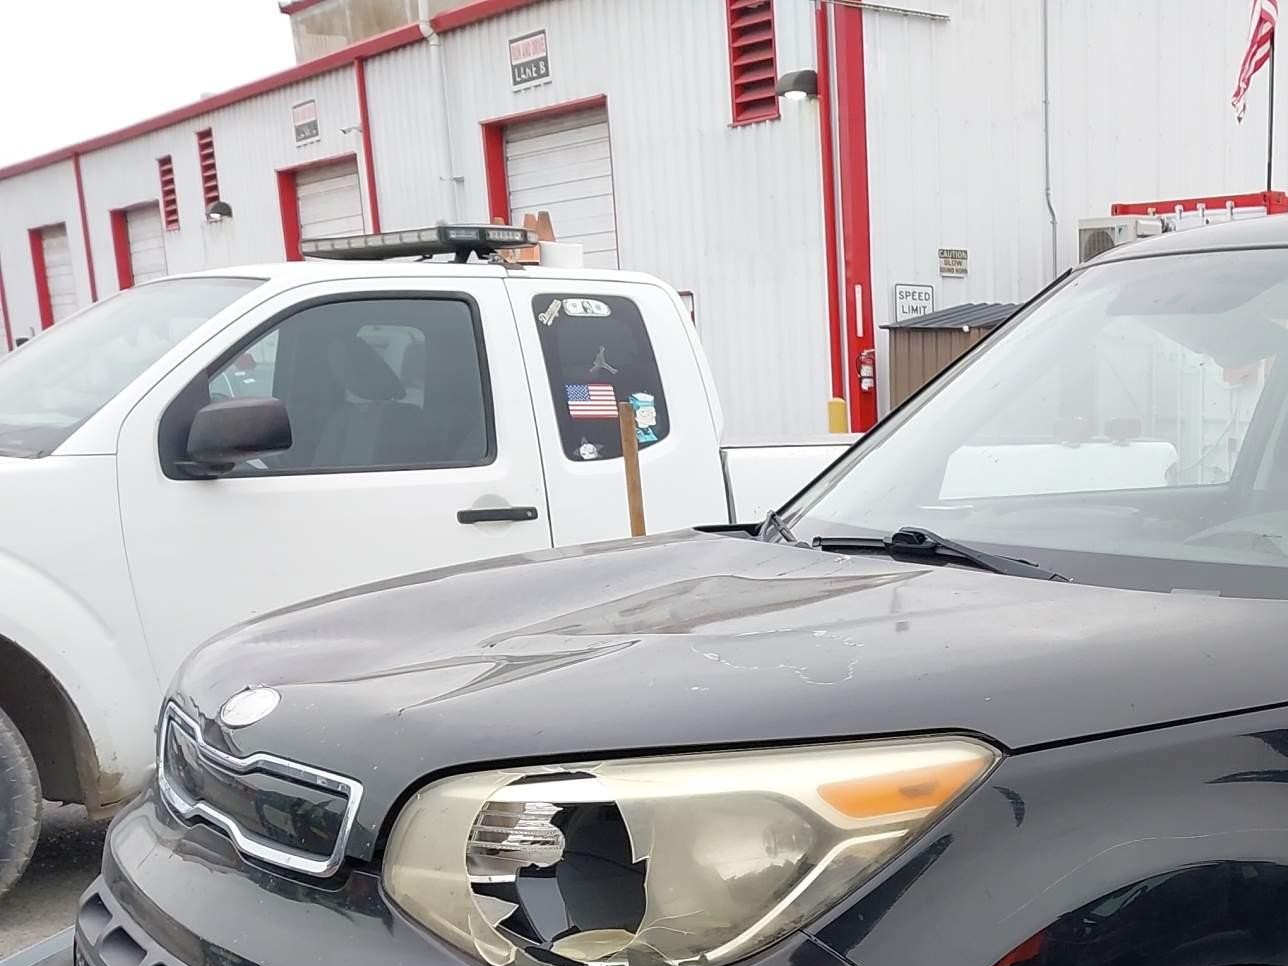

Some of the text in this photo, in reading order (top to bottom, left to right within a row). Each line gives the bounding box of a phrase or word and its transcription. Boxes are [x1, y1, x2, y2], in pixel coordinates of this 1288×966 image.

[514, 64, 538, 81] LANE
[898, 291, 931, 301] SPEED
[902, 305, 928, 315] LIMIT
